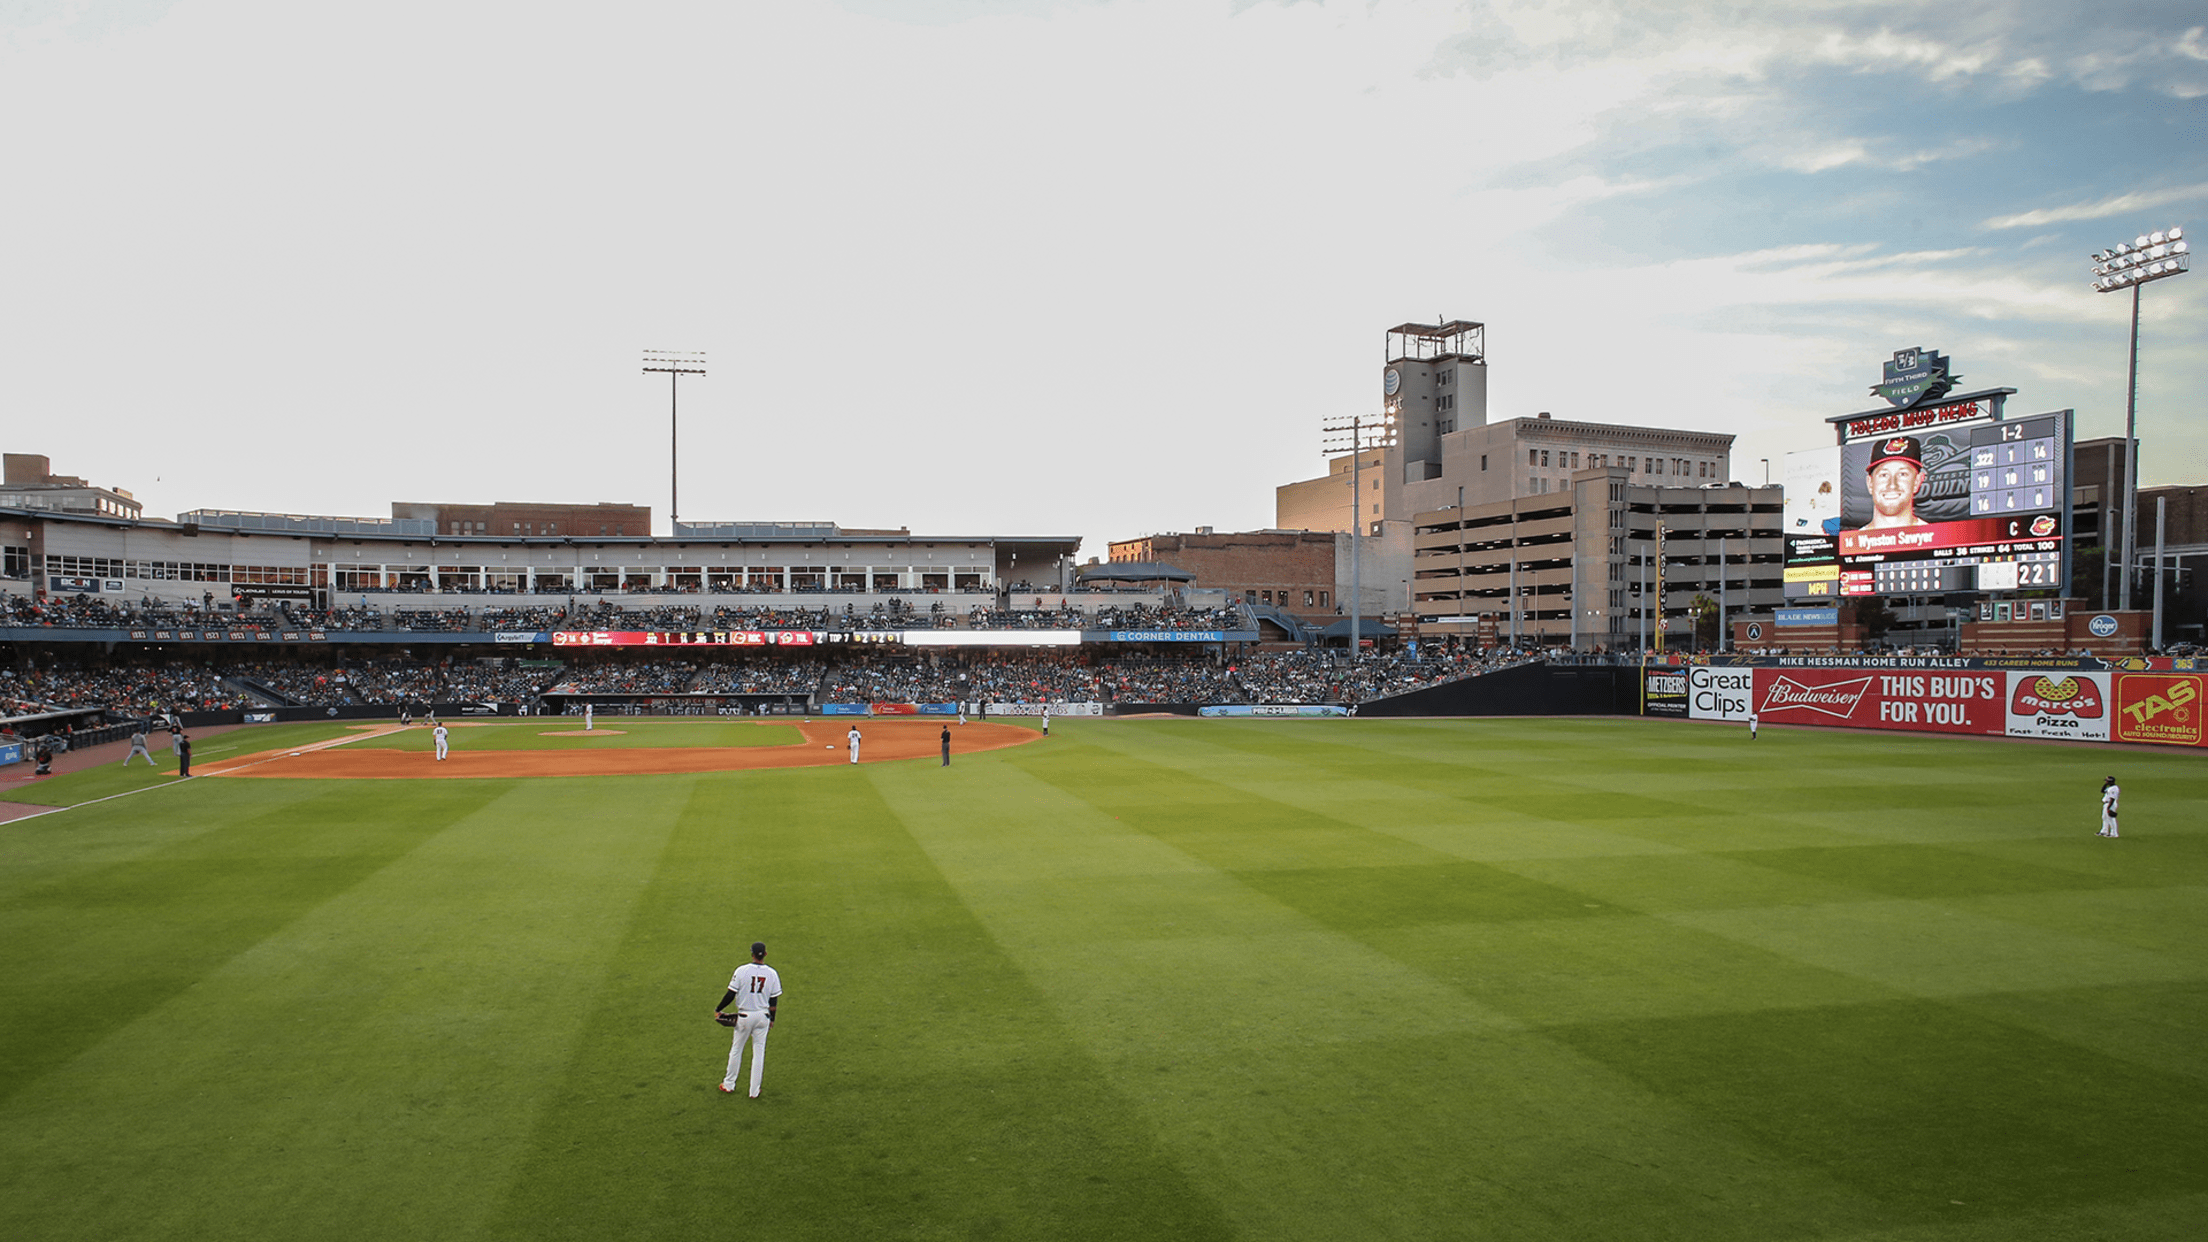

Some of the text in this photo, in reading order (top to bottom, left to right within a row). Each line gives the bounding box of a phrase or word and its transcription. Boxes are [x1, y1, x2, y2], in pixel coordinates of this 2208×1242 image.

[1898, 353, 1914, 368] 5/3
[1885, 372, 1928, 385] FIFTH THIRD
[1892, 385, 1920, 395] FIELD
[1850, 402, 1978, 435] TOLEDO MUD HENS
[2001, 424, 2023, 441] 1-2
[2008, 450, 2014, 462] 1
[1978, 469, 2046, 488] 19 10 10
[2035, 493, 2042, 506] 0
[2009, 521, 2018, 536] C
[1969, 546, 1995, 554] STRIKES
[1997, 544, 2010, 553] 64
[2014, 543, 2034, 551] TOTAL
[2037, 541, 2055, 550] 100
[2019, 563, 2056, 584] 2 2 1
[2093, 619, 2114, 633] Kroger
[769, 633, 775, 644] 0
[817, 633, 823, 644] 2
[829, 634, 849, 642] TOP 7
[862, 634, 868, 643] 2
[879, 634, 884, 643] 2
[896, 633, 900, 643] 1
[1128, 632, 1216, 640] CORNER DENTAL
[1779, 658, 1970, 667] MIKE HESSMAN HOME RUN ALLEY
[2175, 659, 2194, 669] 365
[1649, 676, 1686, 694] METZGERS
[1691, 669, 1751, 689] Great
[1769, 685, 1862, 705] Budweiser
[1880, 676, 1995, 700] THIS BUD'S
[1695, 691, 1746, 718] Clips
[2122, 680, 2196, 723] TAS
[1880, 701, 1971, 725] FOR YOU.
[2037, 716, 2078, 728] Pizza
[2135, 723, 2197, 733] electronics
[750, 976, 766, 993] 17
